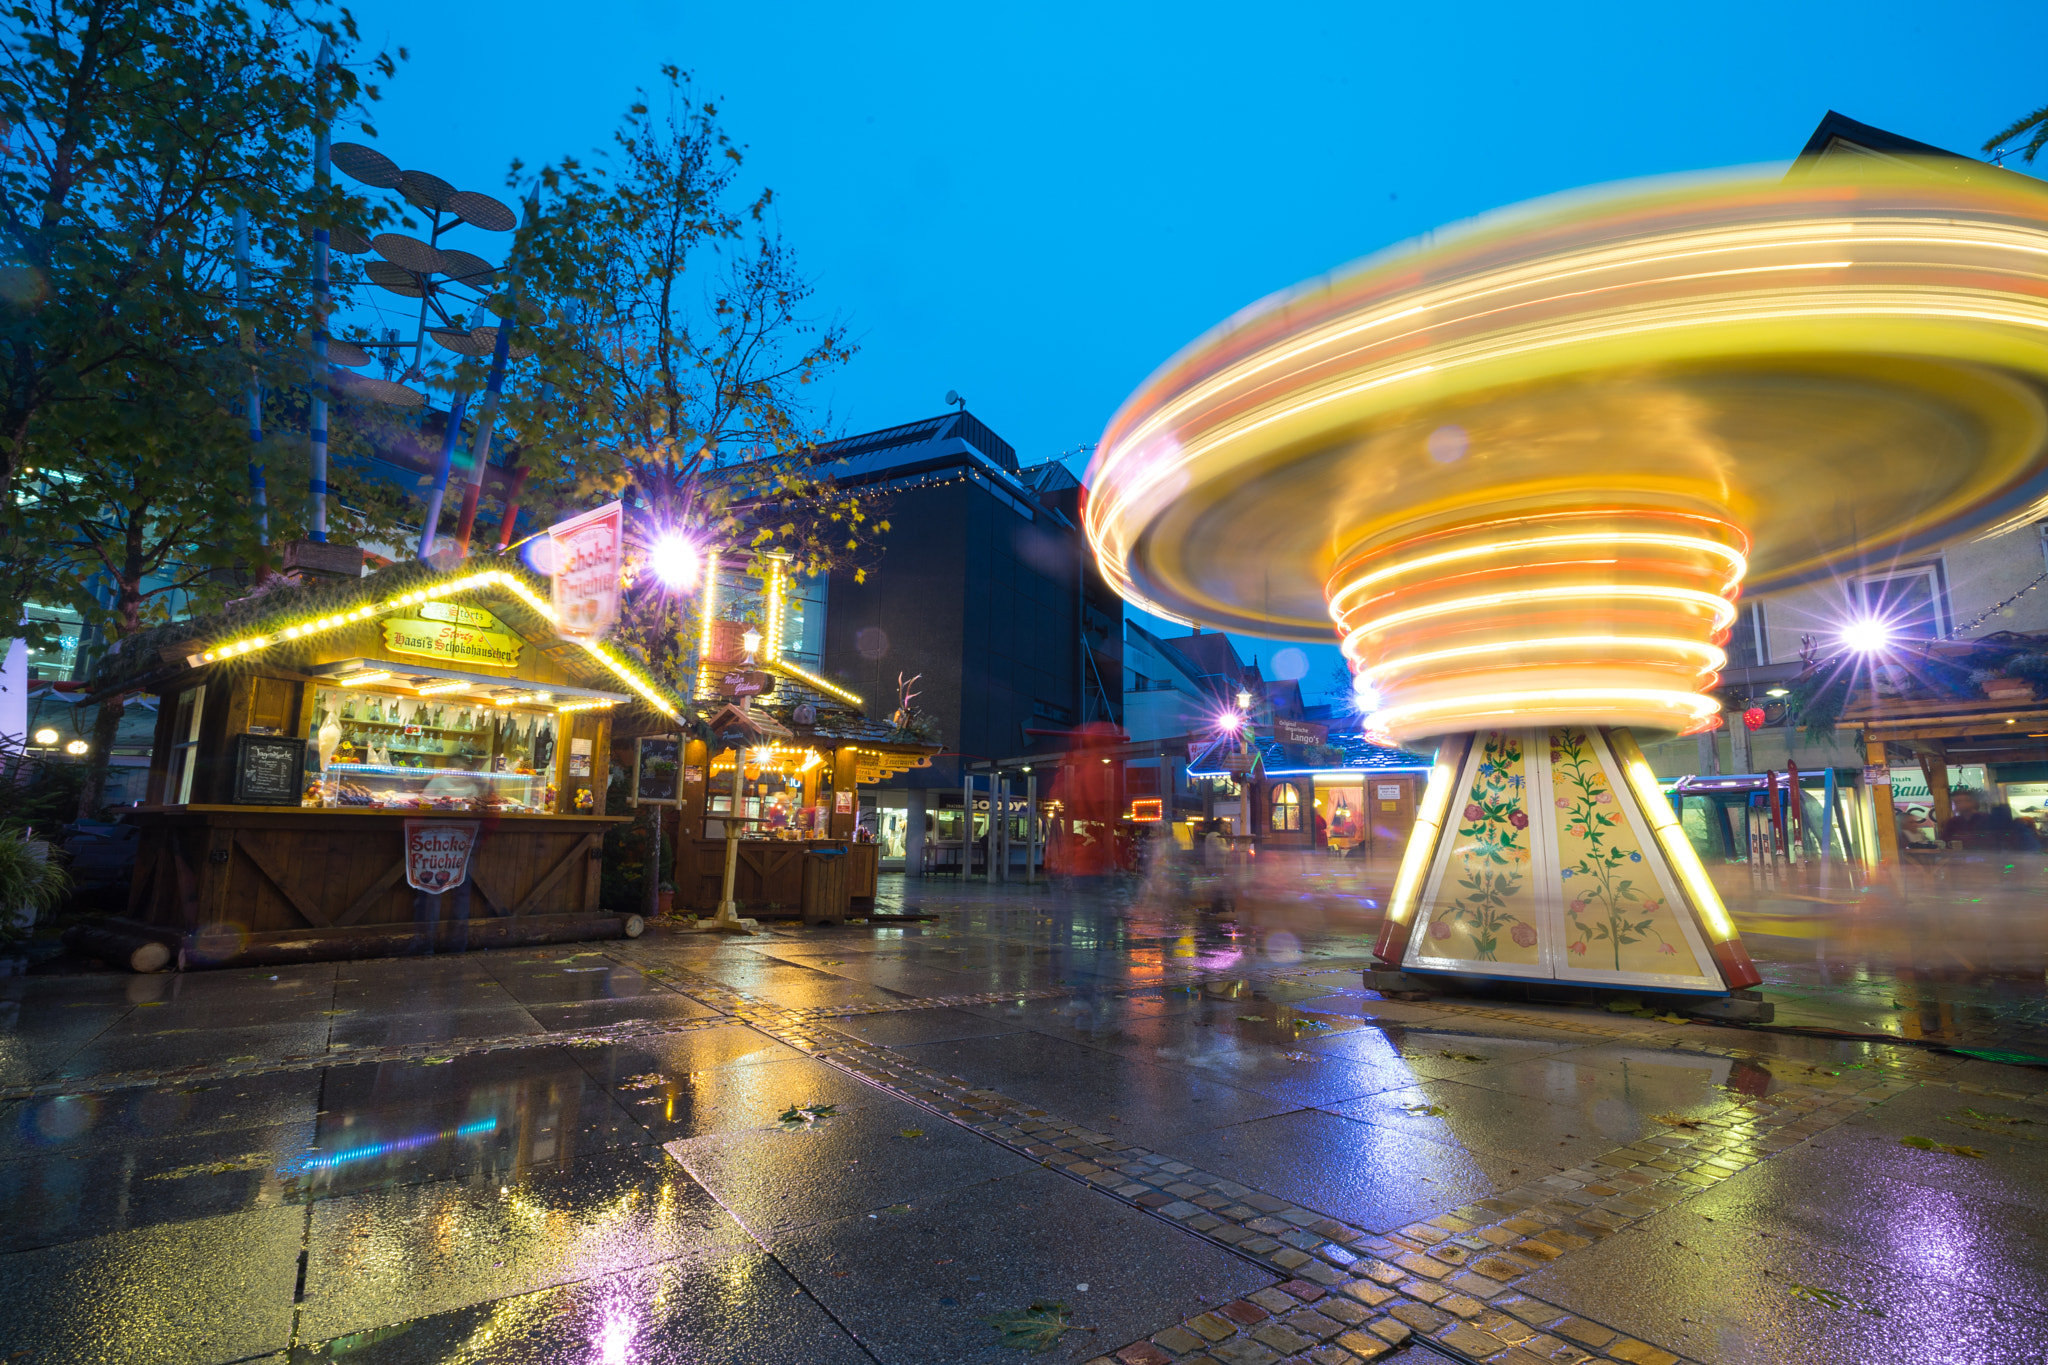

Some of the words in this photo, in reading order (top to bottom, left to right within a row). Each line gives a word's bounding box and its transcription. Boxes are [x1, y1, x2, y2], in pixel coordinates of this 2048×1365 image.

[394, 631, 433, 649] Haasi's
[434, 638, 512, 661] Schokohäuschen
[1291, 732, 1319, 744] Lango's
[411, 853, 464, 869] Früchte
